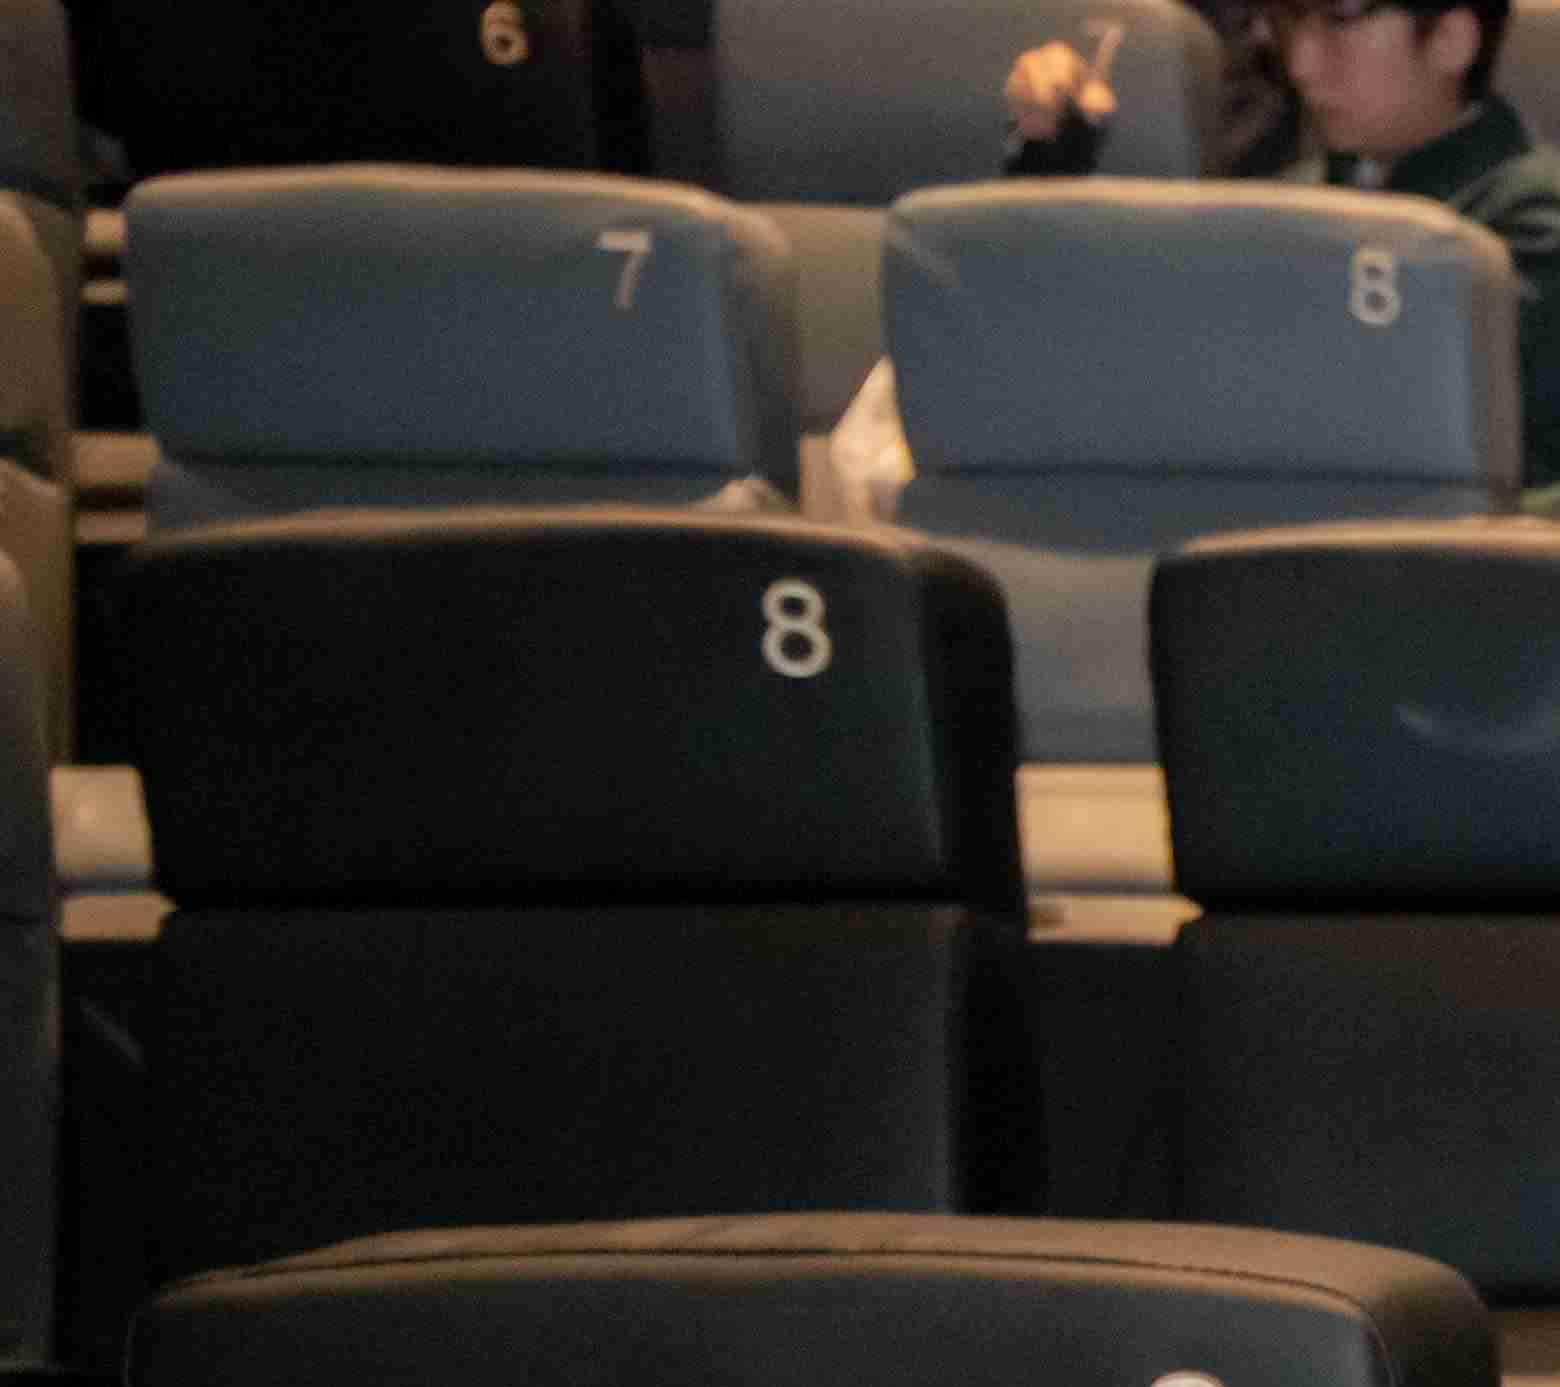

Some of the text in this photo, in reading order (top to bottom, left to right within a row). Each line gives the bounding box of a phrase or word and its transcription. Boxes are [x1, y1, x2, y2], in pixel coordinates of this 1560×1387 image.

[481, 0, 528, 65] 6
[597, 231, 651, 310] 7
[1351, 248, 1401, 326] 8
[763, 578, 832, 678] 8
